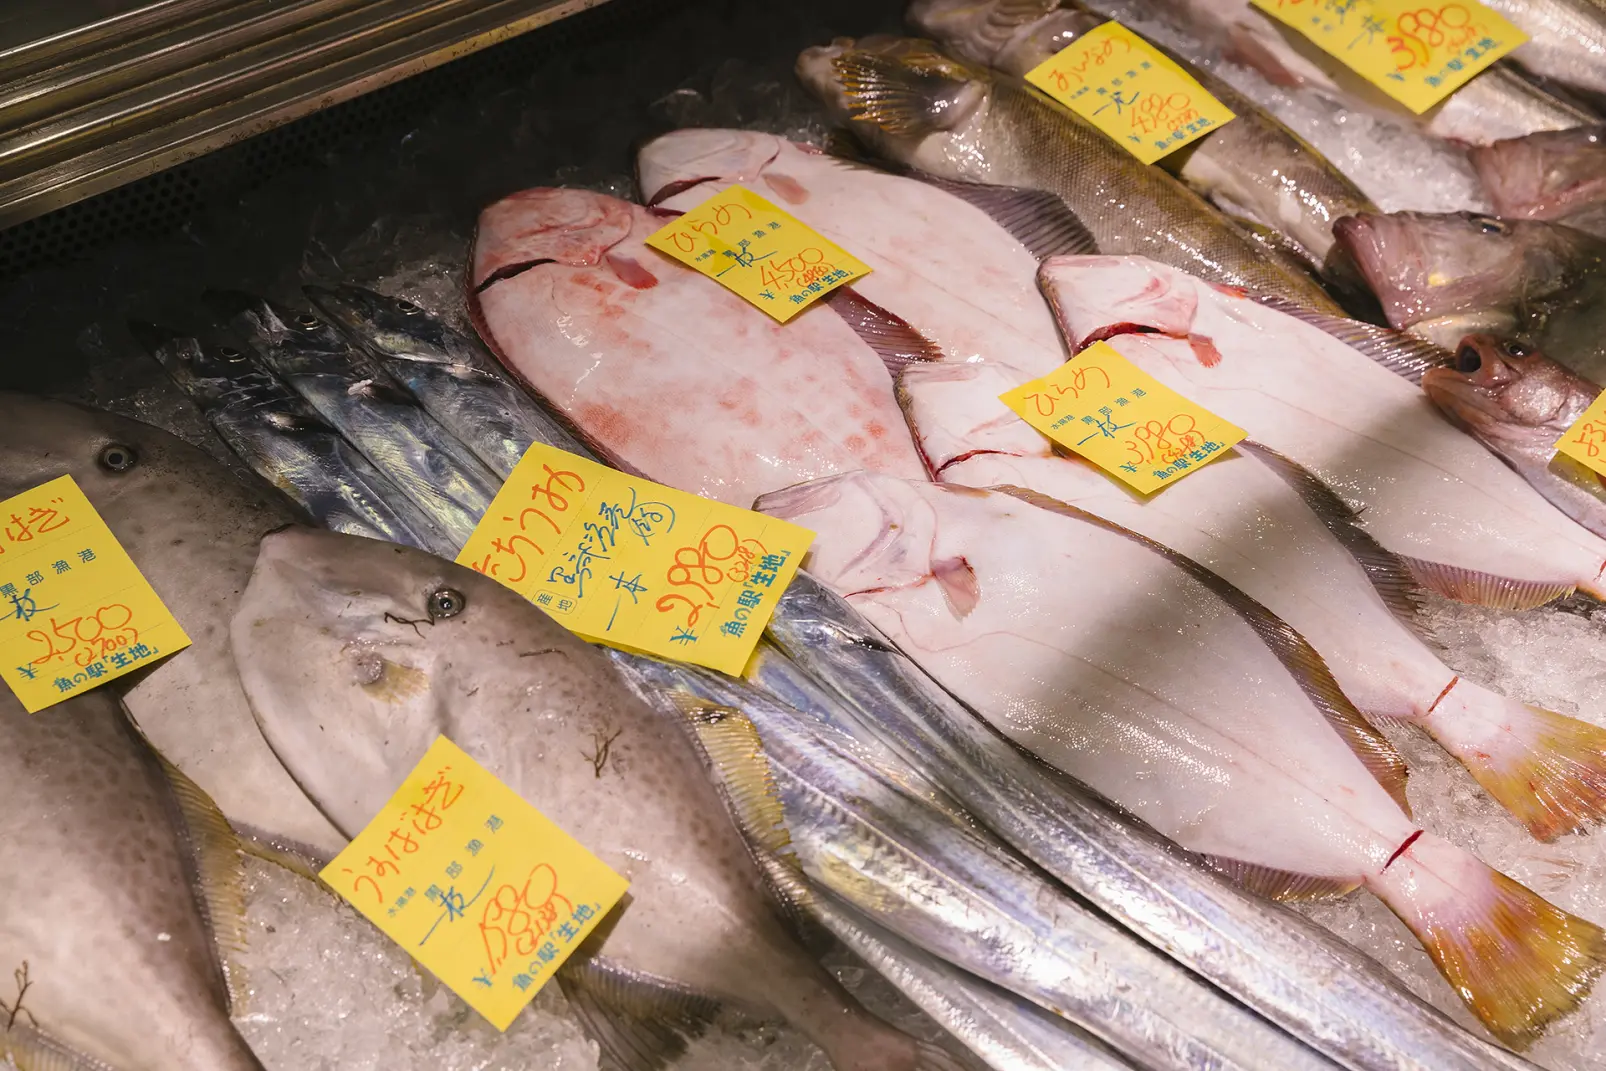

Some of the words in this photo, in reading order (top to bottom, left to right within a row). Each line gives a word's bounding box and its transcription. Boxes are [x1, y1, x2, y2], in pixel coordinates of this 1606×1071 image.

[665, 203, 752, 253] ひらめ
[1024, 366, 1111, 417] ひらめ
[1077, 414, 1137, 446] 一枚
[0, 497, 71, 555] はぎ
[0, 548, 97, 598] 黒部漁港
[536, 592, 574, 613] 産地
[605, 570, 649, 631] 一本
[52, 642, 159, 692] 魚の駅「生地」
[419, 864, 495, 946] 一枚
